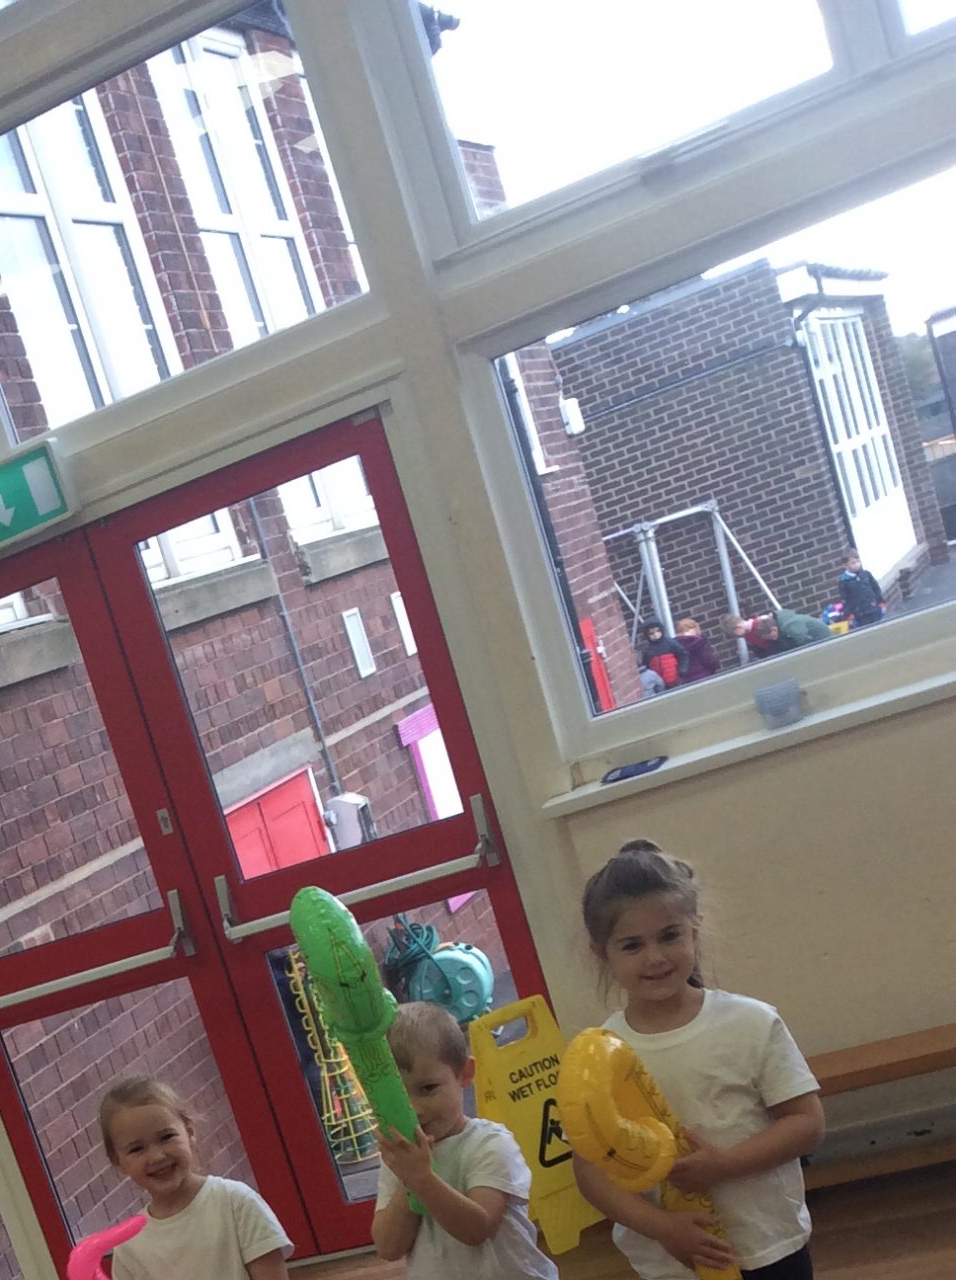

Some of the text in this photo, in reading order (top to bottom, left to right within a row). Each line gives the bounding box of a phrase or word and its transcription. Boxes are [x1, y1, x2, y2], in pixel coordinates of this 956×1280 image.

[509, 1054, 561, 1084] CAUTION
[508, 1082, 535, 1103] WET
[535, 1070, 560, 1092] FLO
